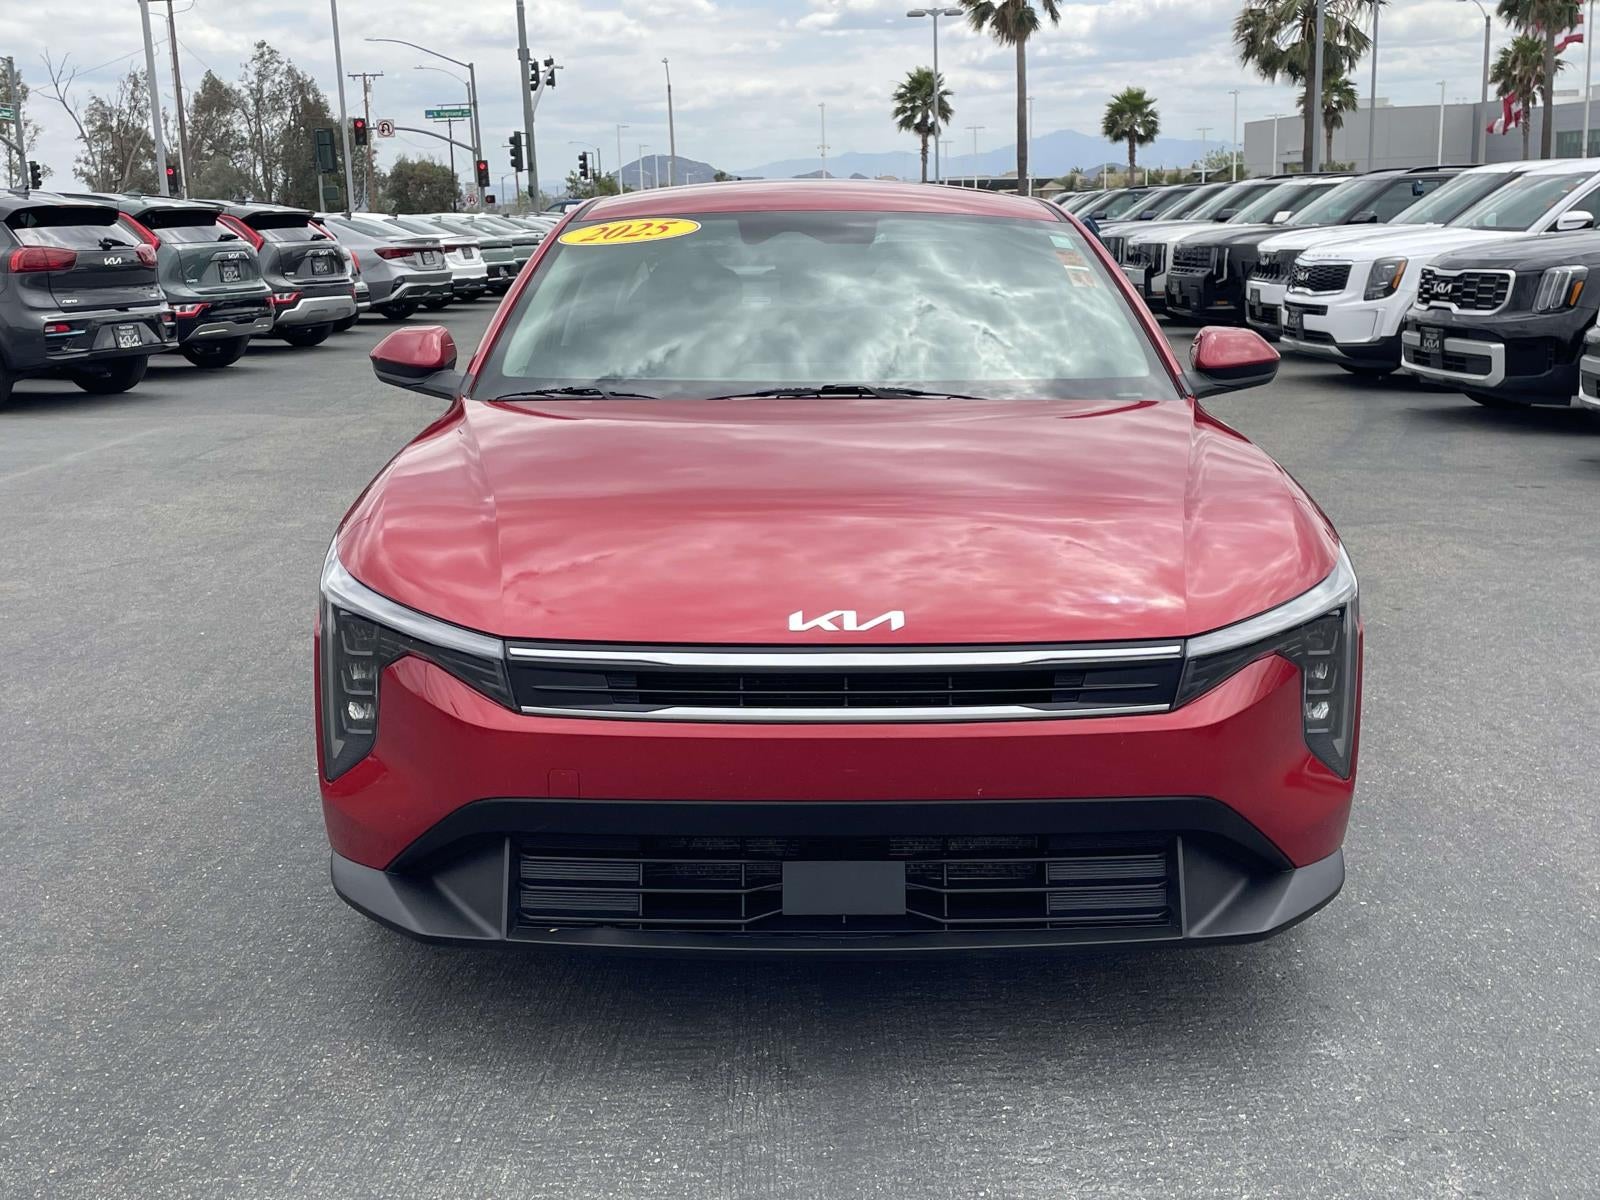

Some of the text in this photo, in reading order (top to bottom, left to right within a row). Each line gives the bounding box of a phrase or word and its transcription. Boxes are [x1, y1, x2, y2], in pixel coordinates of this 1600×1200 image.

[579, 221, 678, 241] 2025
[103, 256, 122, 265] KIA
[1433, 281, 1453, 293] KIA
[119, 335, 139, 345] KIA
[788, 609, 905, 631] KIA
